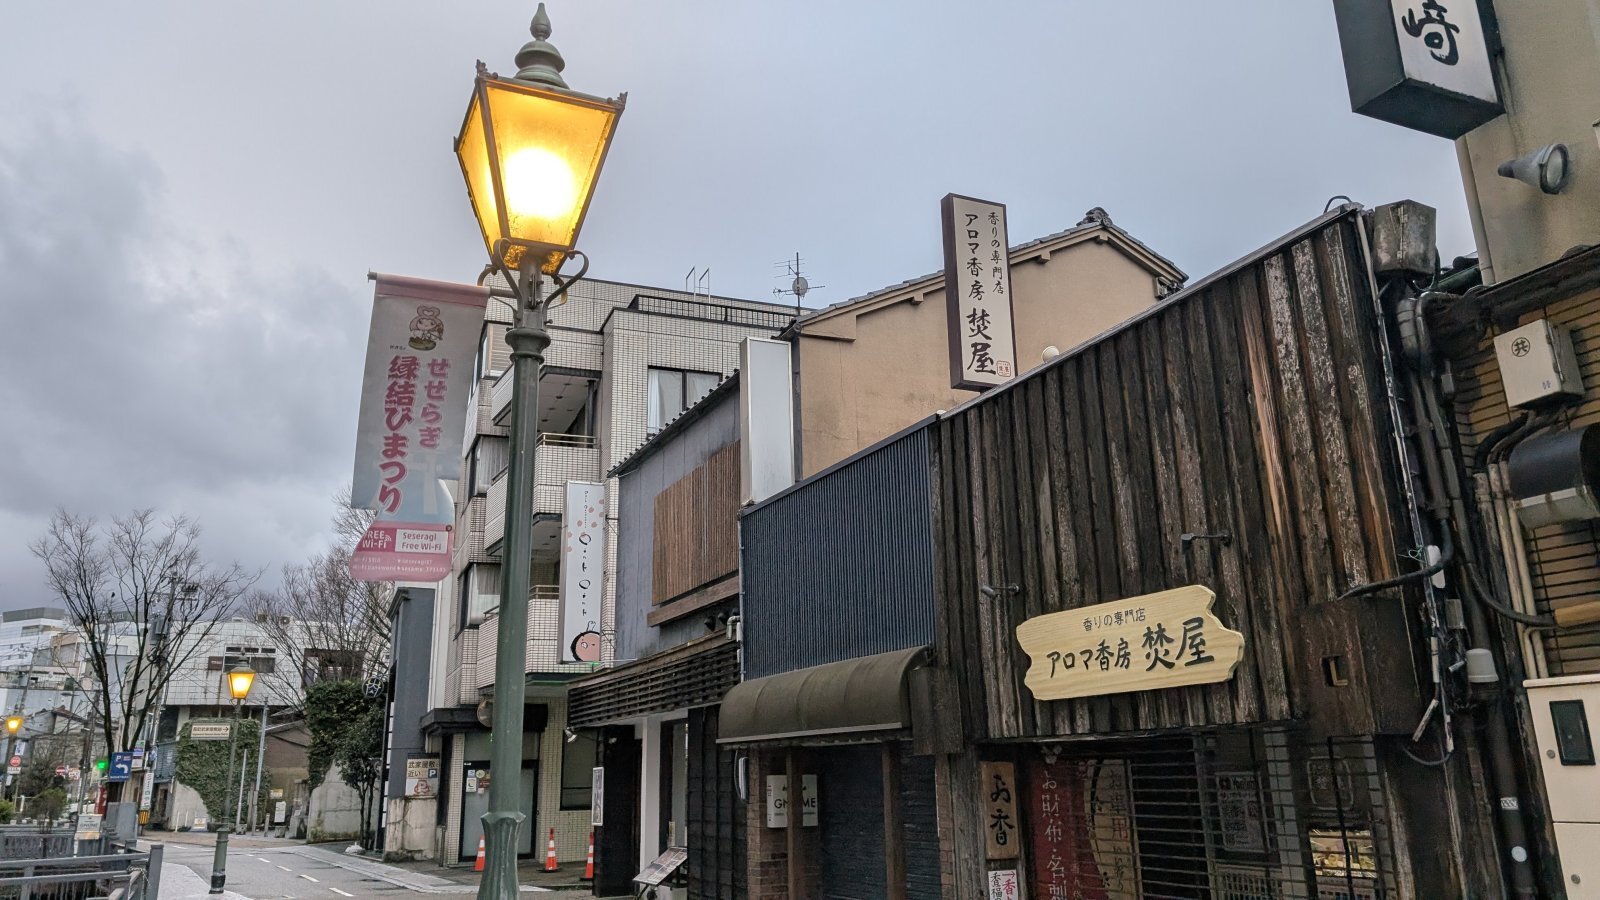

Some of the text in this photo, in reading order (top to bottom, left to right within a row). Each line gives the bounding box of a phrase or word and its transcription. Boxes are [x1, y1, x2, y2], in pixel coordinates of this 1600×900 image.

[988, 212, 1004, 295] 香りの専門店
[965, 213, 996, 375] アロマ香房 焚屋
[419, 358, 449, 449] せせらぎ
[379, 355, 419, 513] 縁結びまつり
[362, 538, 387, 549] Wi-Fi
[402, 532, 437, 542] Seseragi
[402, 541, 441, 551] Free Wi-Fi
[1082, 608, 1147, 631] 香りの専門店
[1046, 616, 1215, 678] アロマ香房 焚屋
[429, 769, 437, 777] P
[774, 797, 816, 809] GNME
[990, 774, 1015, 846] お香
[1041, 770, 1068, 900] お財布・名刺
[990, 872, 1003, 900] 香福
[1002, 879, 1016, 900] 香
